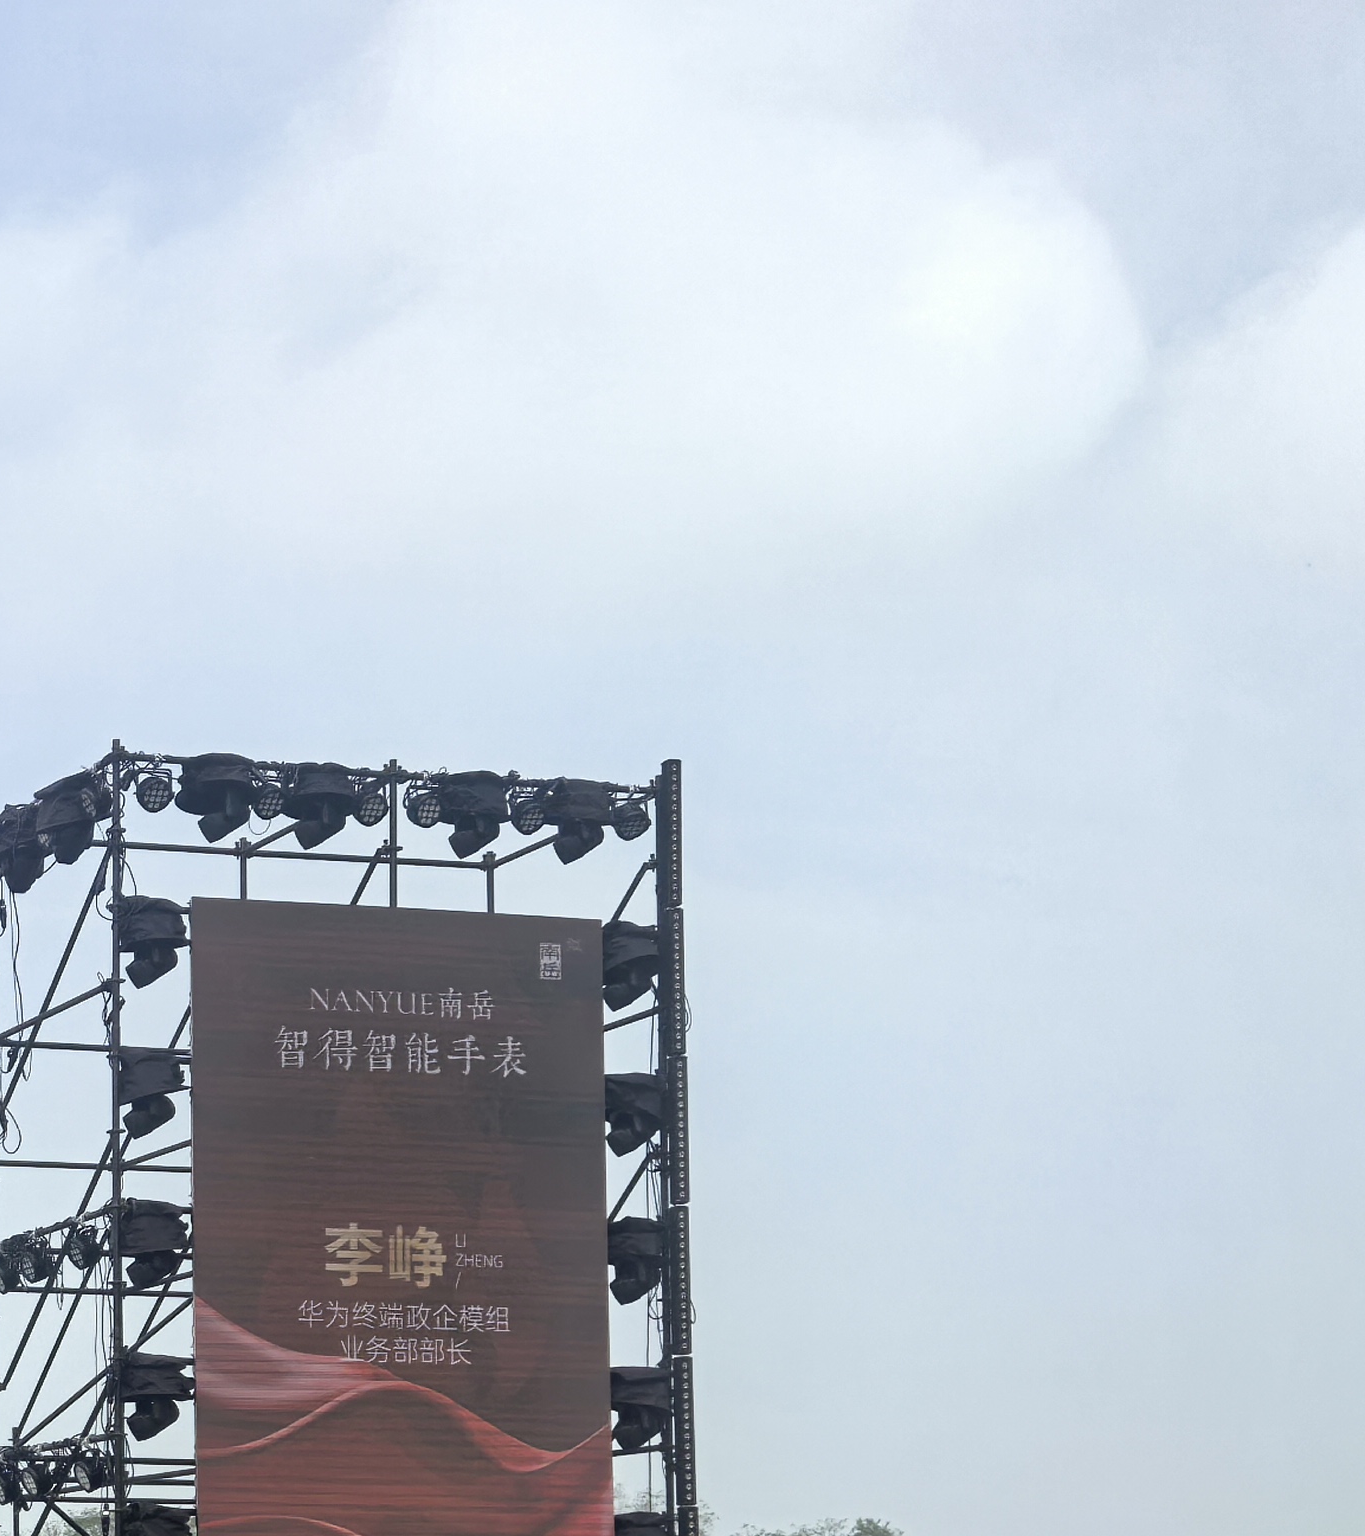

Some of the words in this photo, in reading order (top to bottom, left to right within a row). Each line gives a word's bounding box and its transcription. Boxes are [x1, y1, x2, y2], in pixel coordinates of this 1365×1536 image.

[274, 1025, 527, 1078] 智得智能手表
[324, 1222, 447, 1288] 李峥
[455, 1252, 504, 1268] ZHENG
[298, 1299, 512, 1333] 华为终端政企模组
[340, 1334, 472, 1365] 业务部部长
